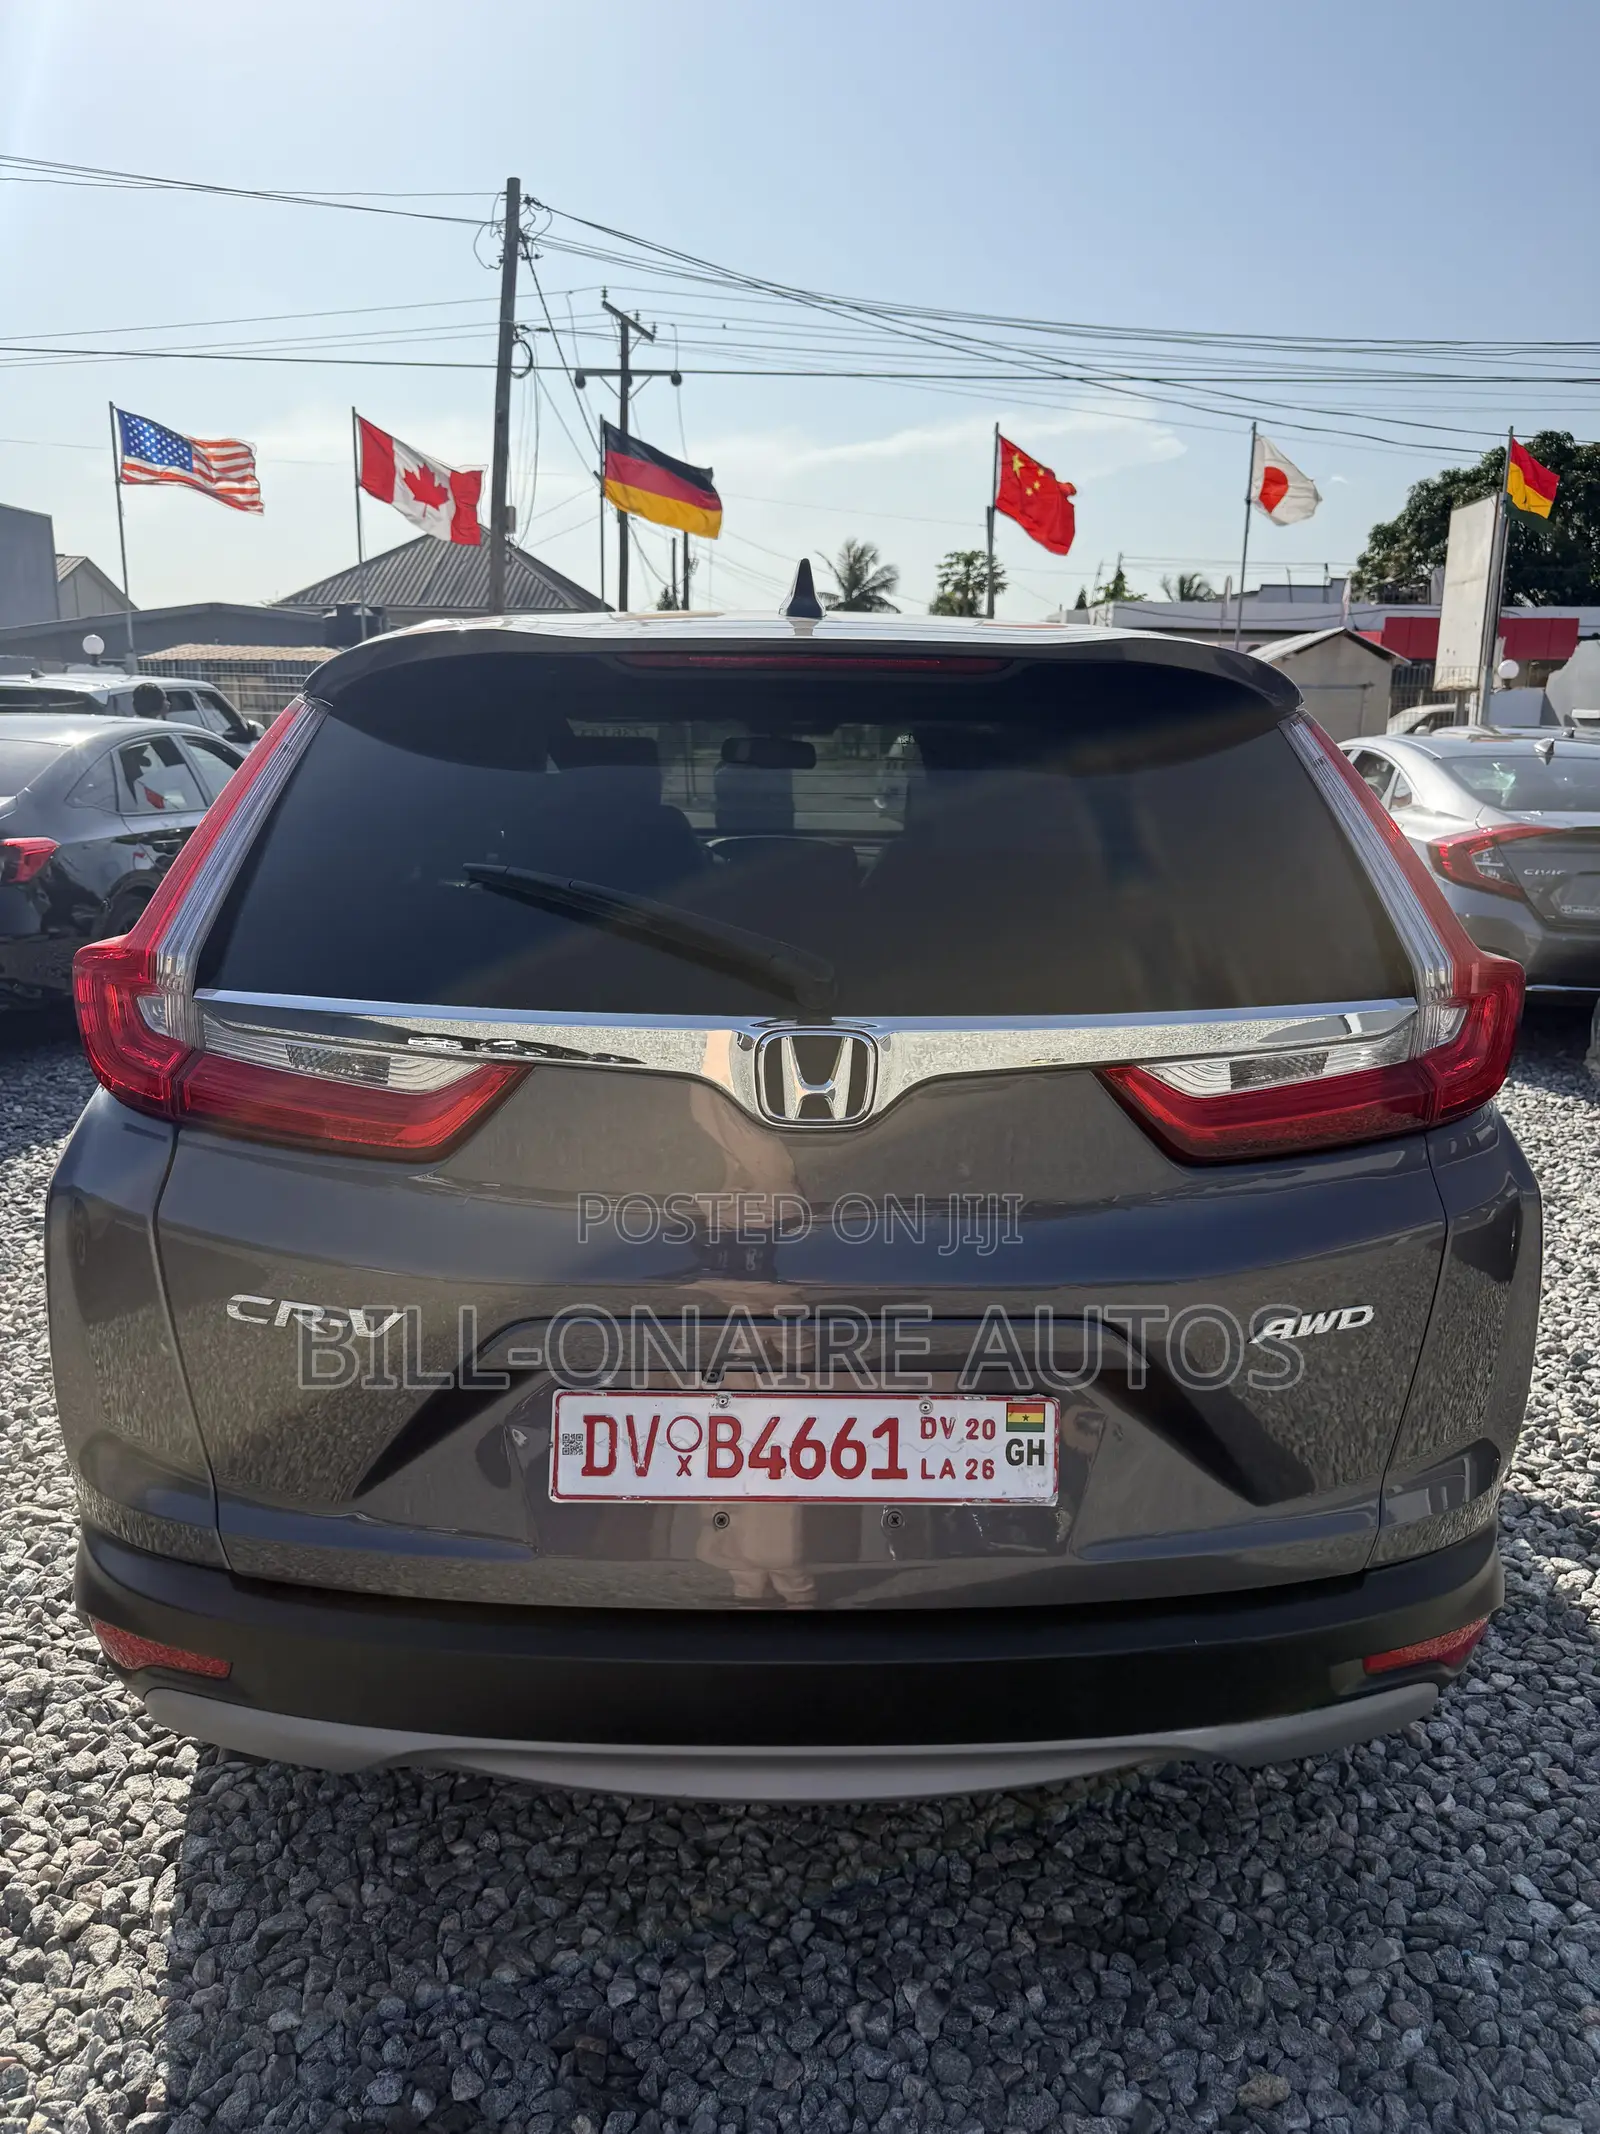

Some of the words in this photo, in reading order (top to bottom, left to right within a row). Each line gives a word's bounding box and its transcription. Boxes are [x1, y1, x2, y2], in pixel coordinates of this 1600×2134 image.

[226, 1293, 407, 1338] CR-V
[1248, 1304, 1375, 1344] AWD
[920, 1416, 956, 1440] DV
[965, 1417, 996, 1441] 20
[1005, 1437, 1046, 1467] GH
[920, 1457, 956, 1480] LA
[965, 1457, 995, 1480] 26
